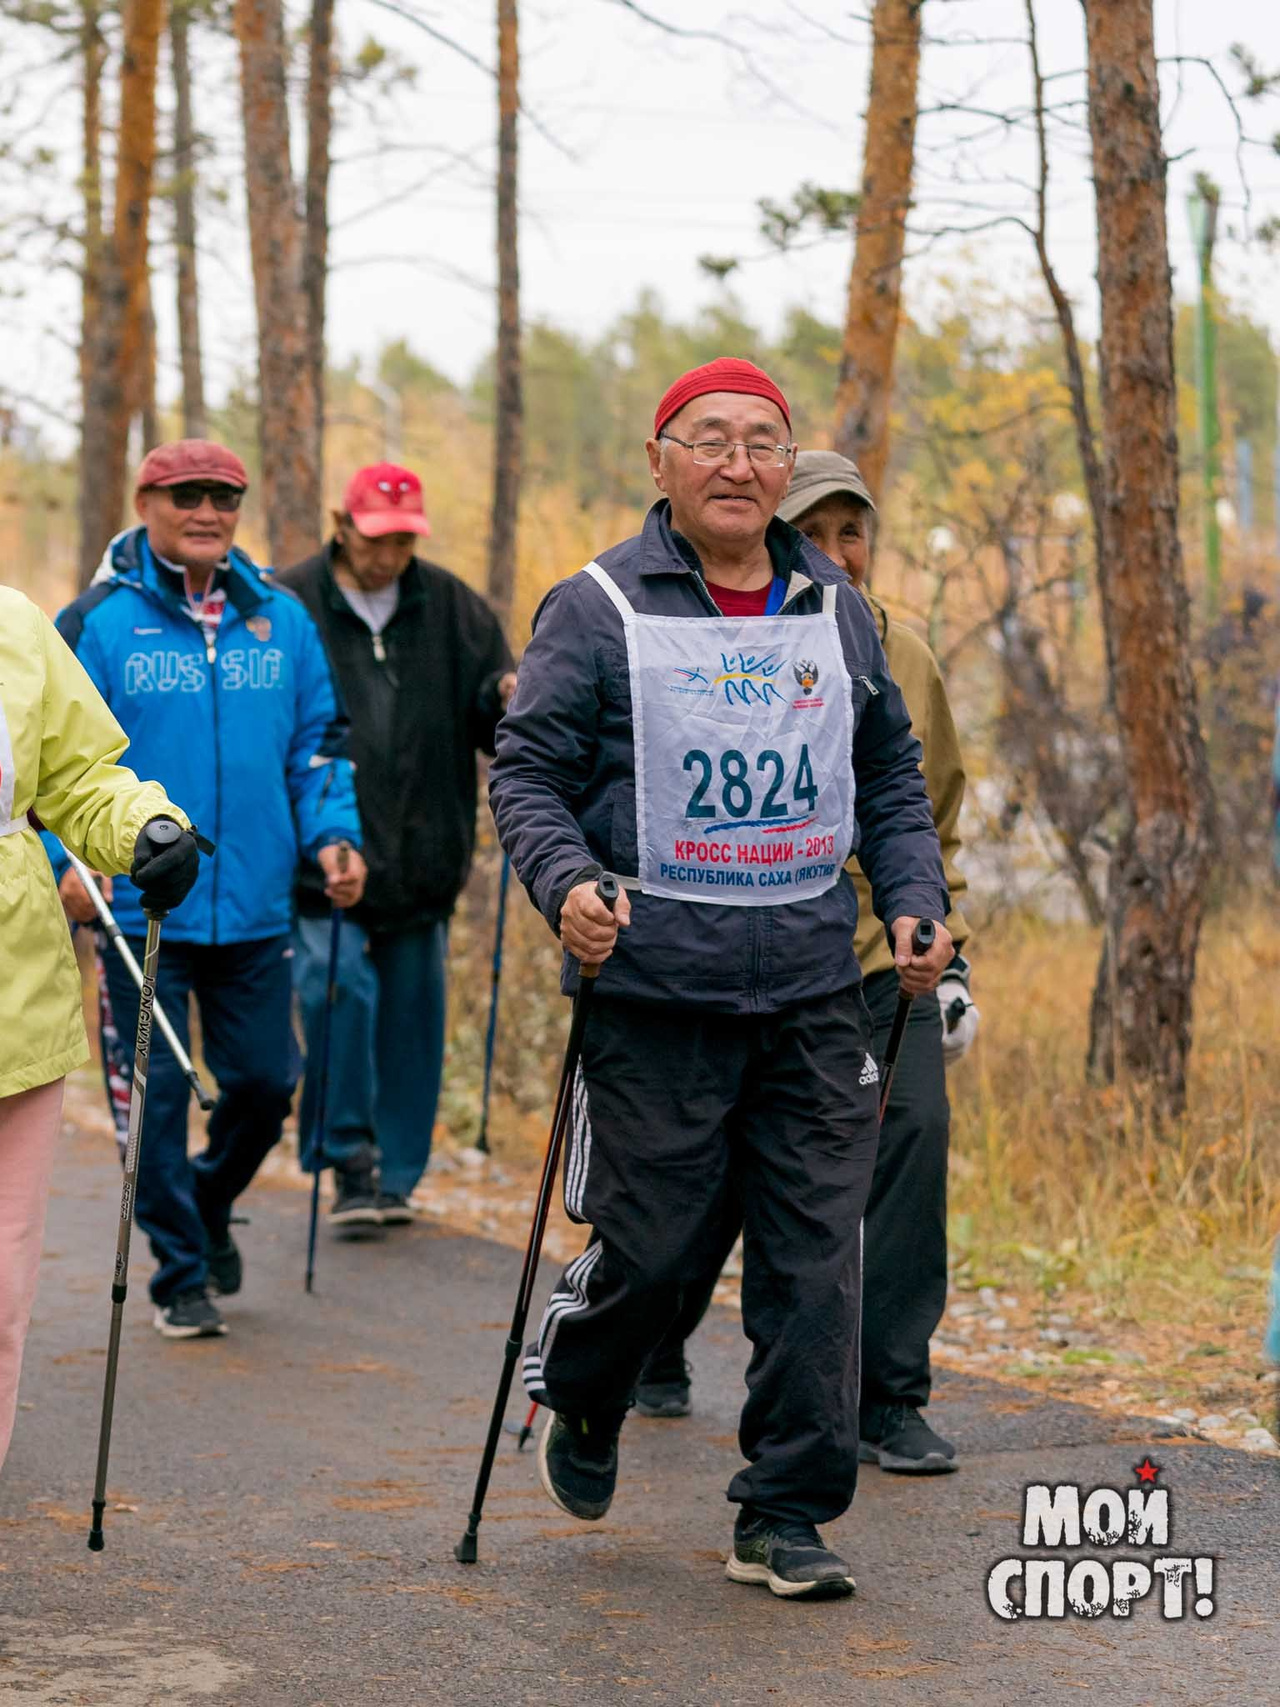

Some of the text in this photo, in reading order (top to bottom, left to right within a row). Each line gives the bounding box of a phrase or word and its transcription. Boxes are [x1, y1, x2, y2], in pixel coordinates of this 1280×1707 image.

[683, 744, 818, 819] 2824
[660, 863, 755, 887] РЕСПУБЛИКА
[759, 871, 791, 887] САХА
[675, 840, 731, 863] КРОСС
[737, 841, 793, 867] НАЦИИ
[806, 835, 834, 858] 2013
[136, 974, 155, 1058] LONGWAY
